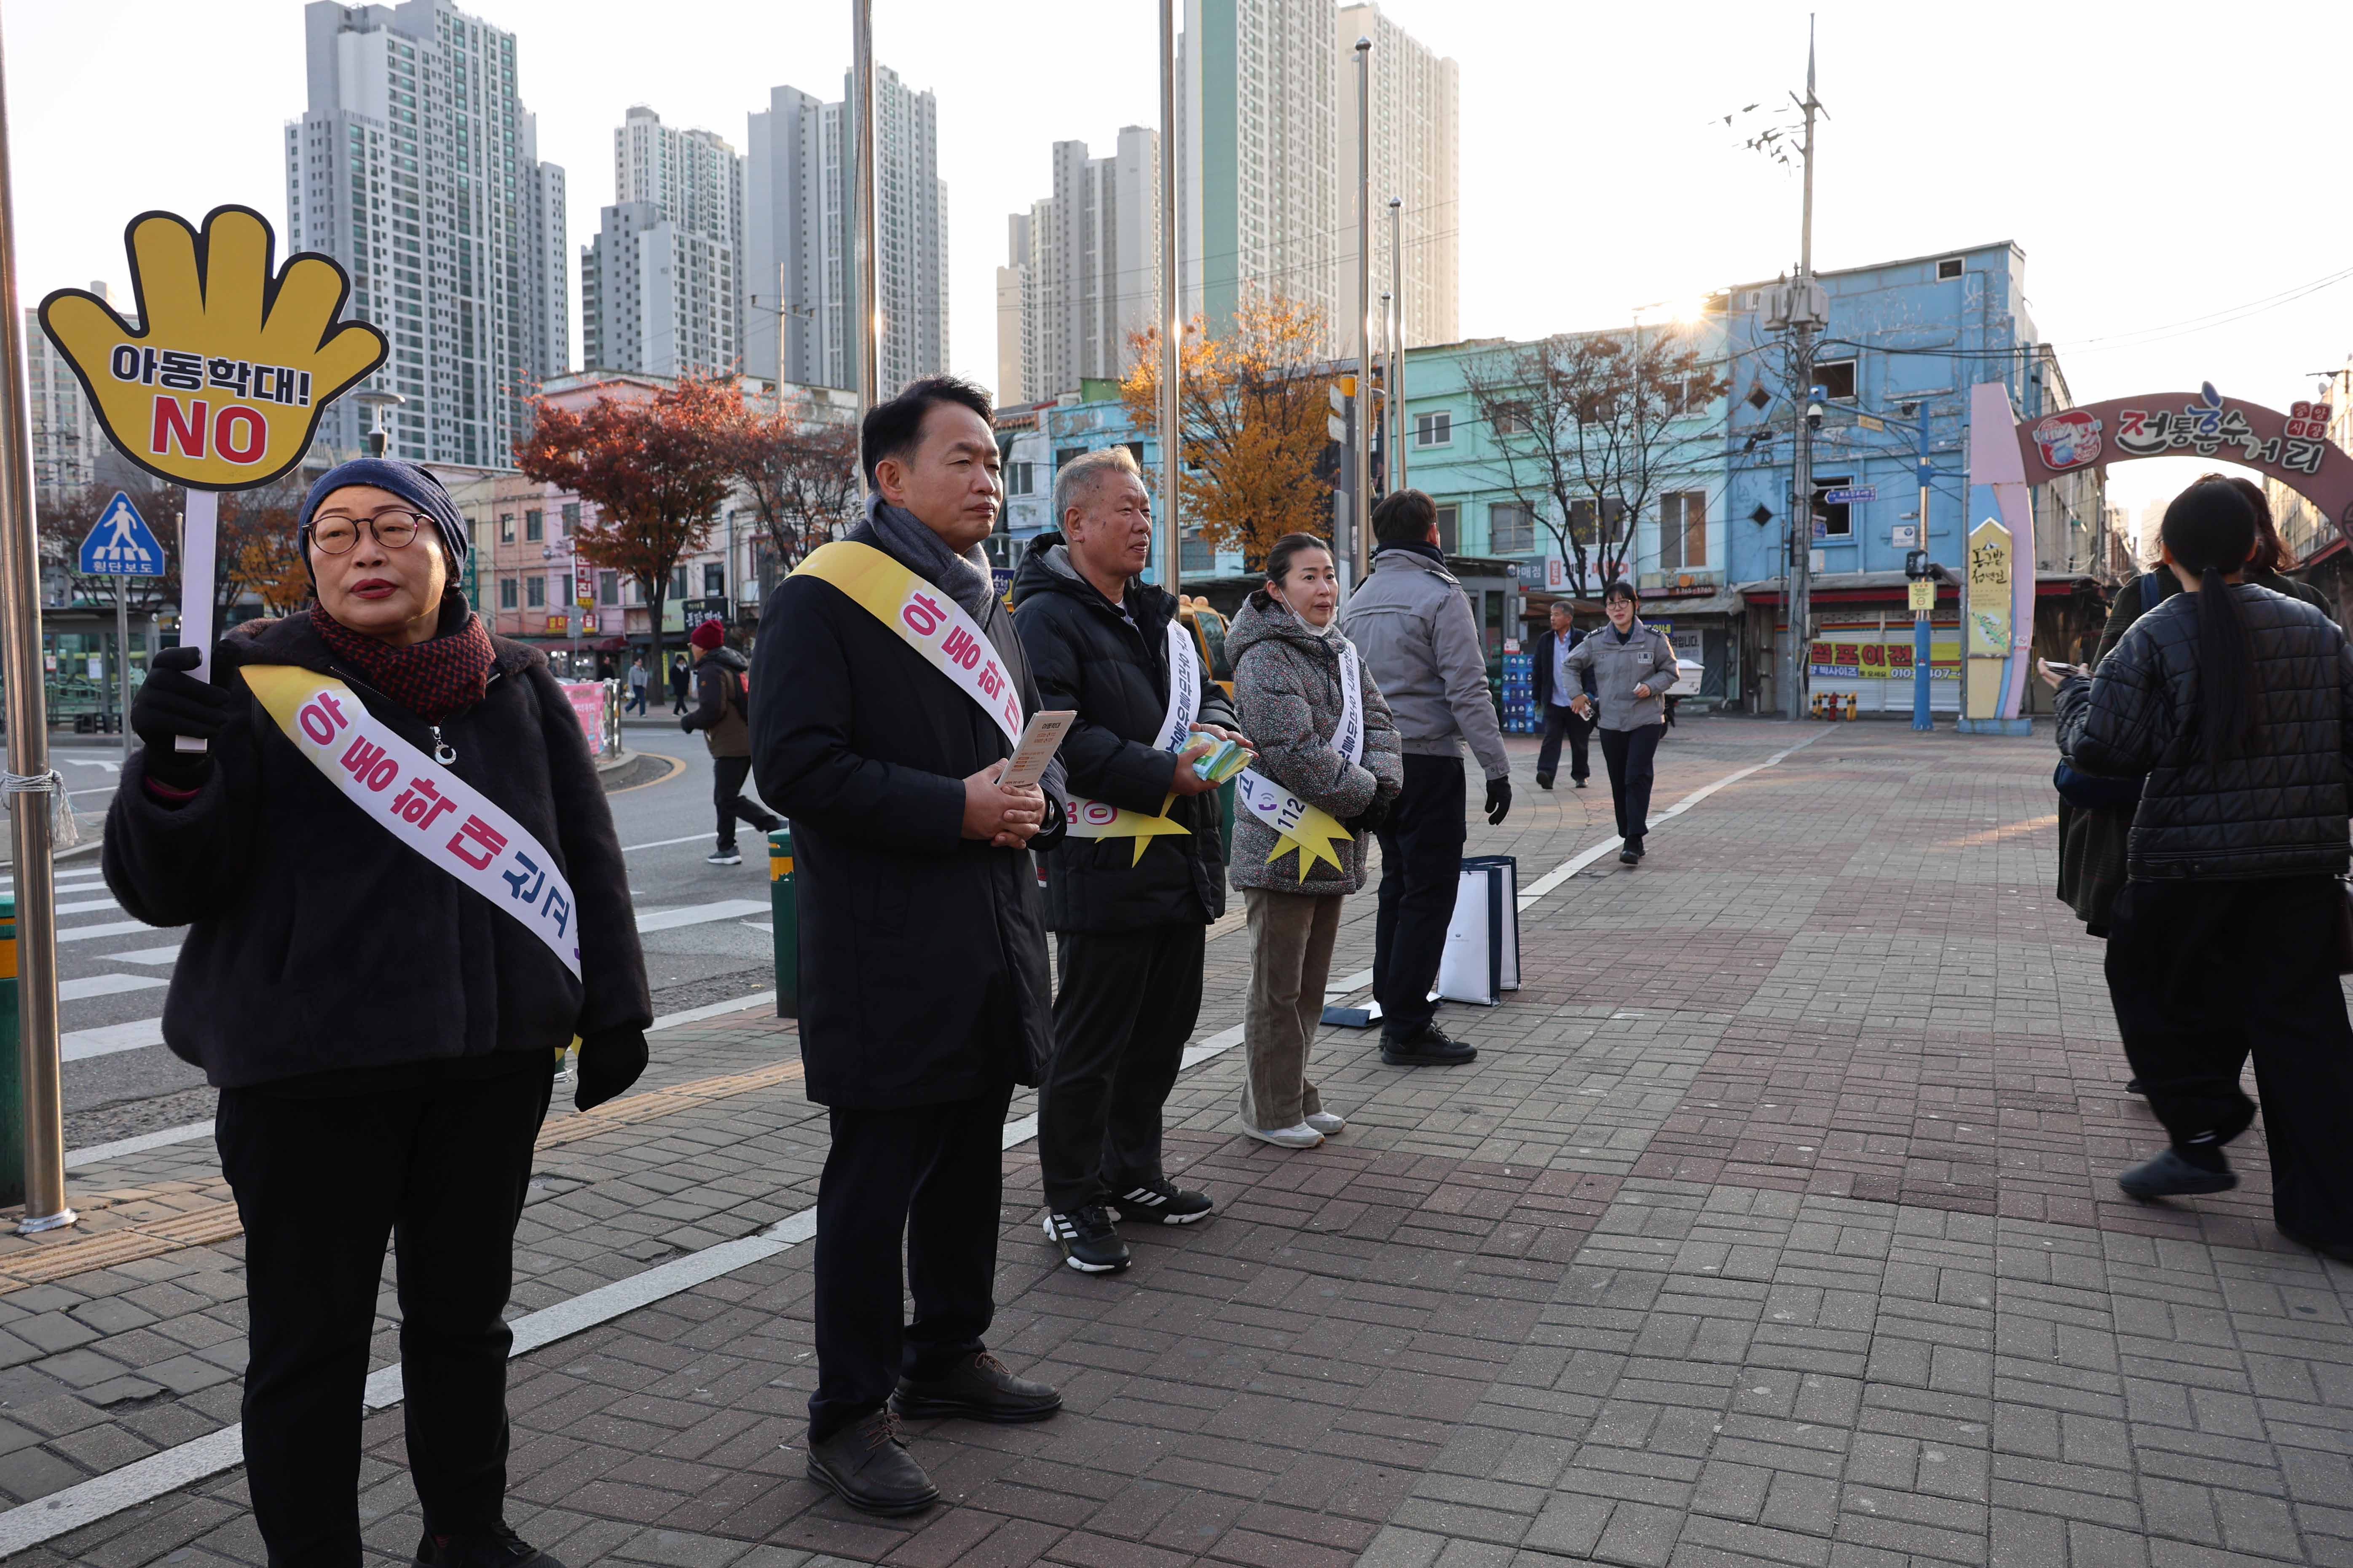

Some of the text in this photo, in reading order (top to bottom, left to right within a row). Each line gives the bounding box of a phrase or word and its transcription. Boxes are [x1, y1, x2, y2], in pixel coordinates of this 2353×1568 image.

[114, 345, 311, 406] 아동학대!
[153, 396, 266, 463] NO
[2290, 422, 2323, 437] 시장
[93, 560, 153, 573] 횡단보도
[1820, 666, 1858, 677] 빅사이즈
[1277, 797, 1306, 829] 112
